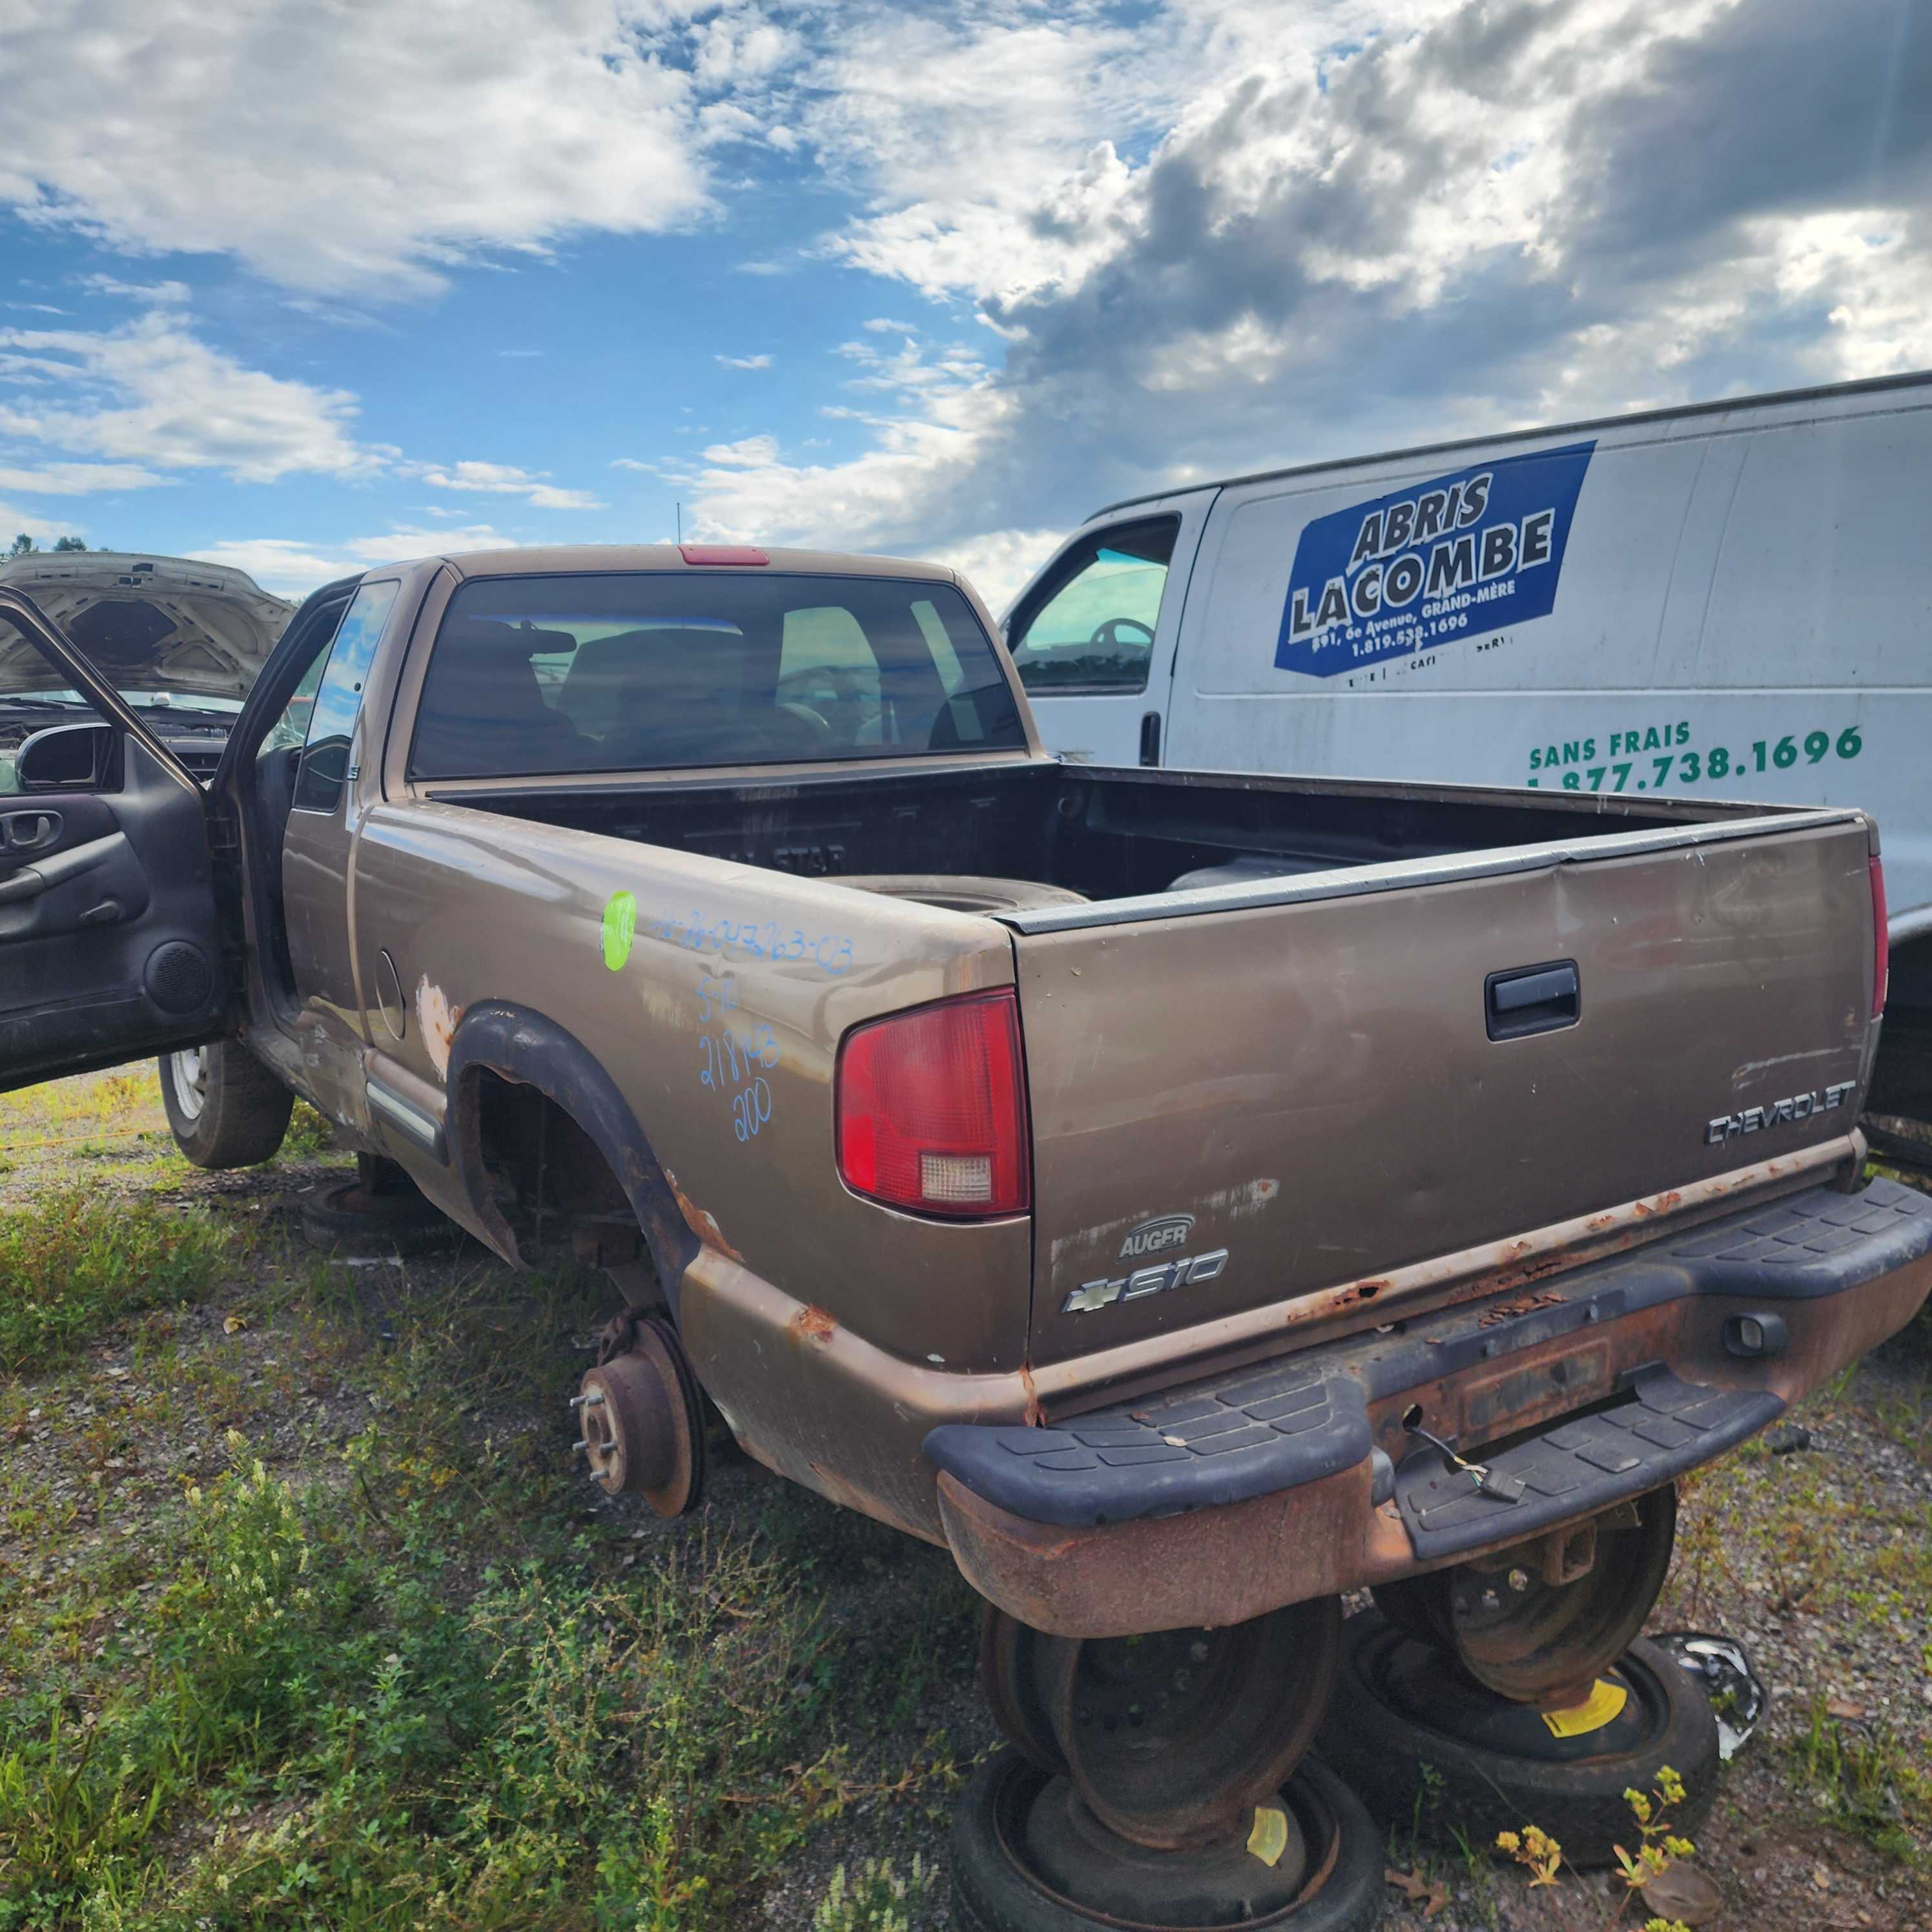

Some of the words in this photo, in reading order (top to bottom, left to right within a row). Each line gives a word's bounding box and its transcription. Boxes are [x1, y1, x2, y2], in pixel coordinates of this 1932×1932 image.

[1346, 472, 1494, 577] ABRIS
[1288, 508, 1556, 644] LACOMBE
[1351, 613, 1468, 657] 1.819.538.1696
[1365, 612, 1418, 638] Avenue,
[1421, 580, 1516, 620] GRAND-MÈRE
[1529, 738, 1596, 770] SANS
[1609, 721, 1690, 756] FRAIS
[733, 1076, 772, 1142] 200
[1706, 1079, 1857, 1144] CHEVROLET
[1118, 1224, 1187, 1259] AUGER
[1122, 1248, 1229, 1303] S10
